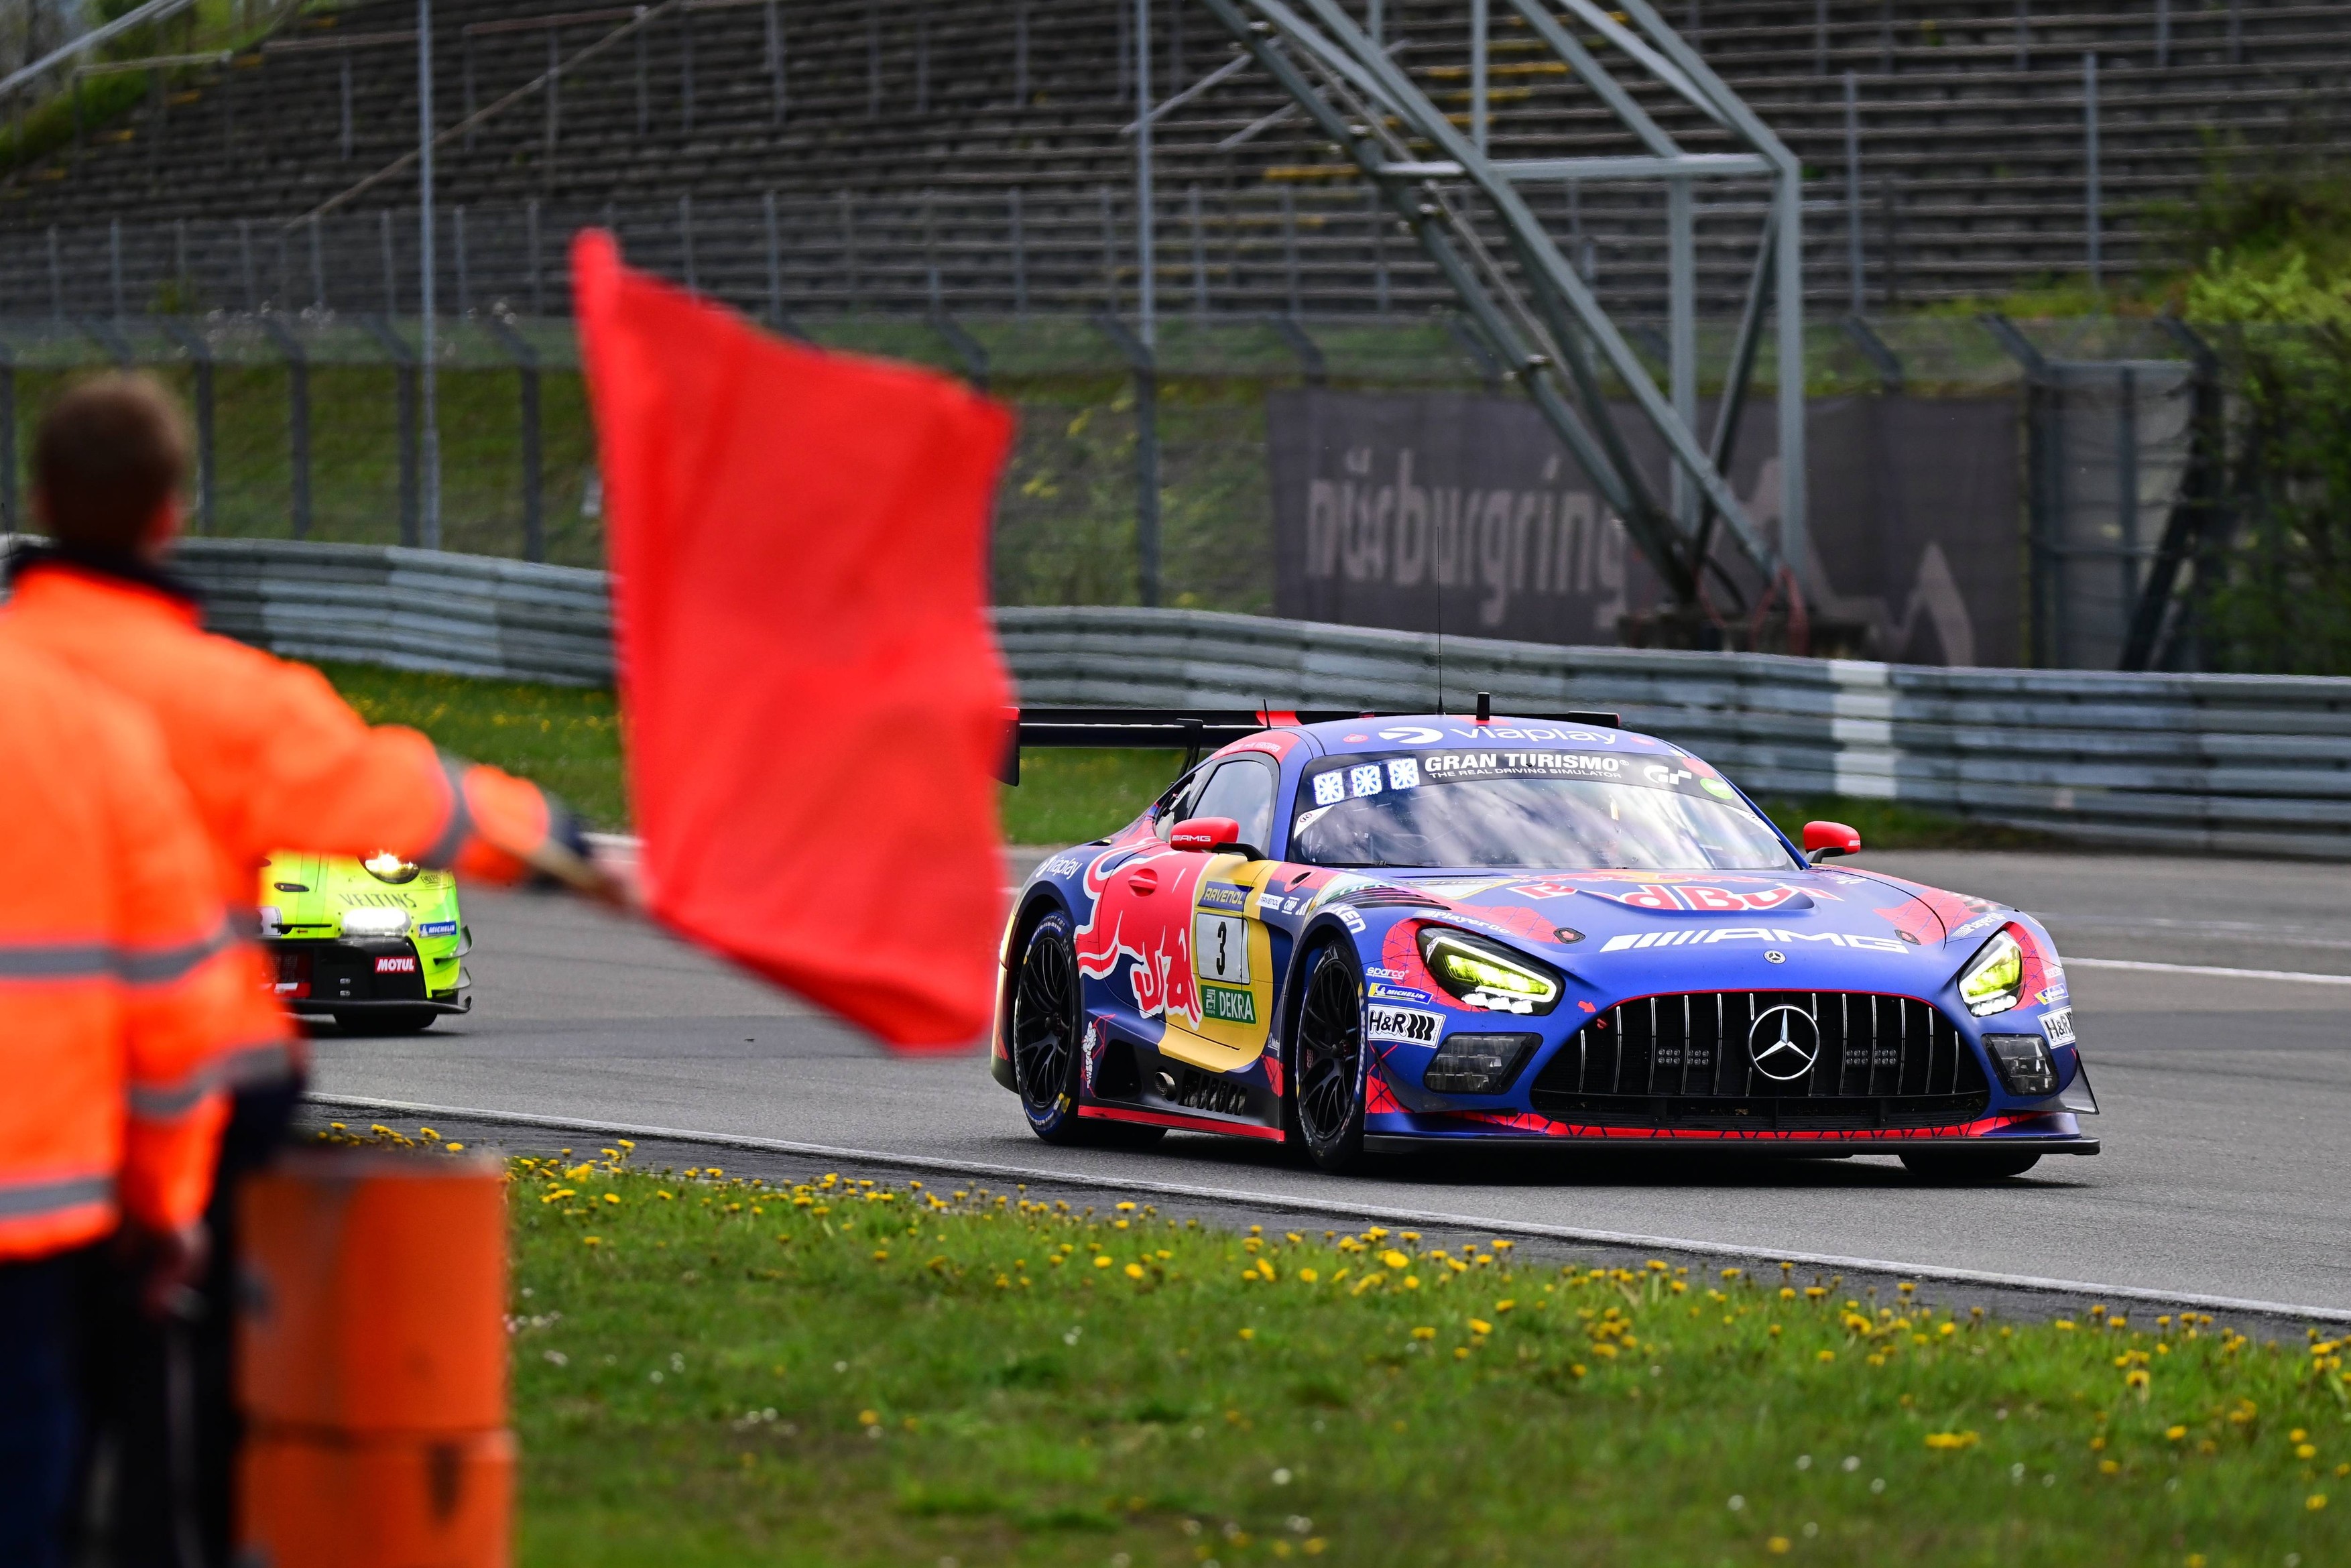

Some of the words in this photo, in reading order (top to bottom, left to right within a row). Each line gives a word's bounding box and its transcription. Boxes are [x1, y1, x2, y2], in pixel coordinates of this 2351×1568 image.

[1450, 725, 1616, 745] viaplay
[1425, 753, 1497, 772] GRAN
[1460, 769, 1493, 777] REAL
[1550, 768, 1622, 778] SIMULATOR
[1048, 857, 1083, 880] viaplay
[339, 893, 417, 908] VELTINS
[1205, 888, 1243, 905] RAVENOL
[1260, 896, 1279, 906] RAVENOL
[1283, 899, 1298, 911] OMP
[1506, 882, 1685, 910] Rd
[1329, 904, 1366, 934] LKEN
[428, 924, 455, 934] MICHELIN
[1216, 921, 1227, 975] 3
[1709, 928, 1910, 954] AMG
[377, 957, 414, 971] MOTUL
[1367, 967, 1405, 977] sparco
[1386, 989, 1426, 1000] MICHELIN
[1219, 991, 1254, 1021] DEKRA
[1370, 1010, 1406, 1034] H&R
[2045, 1014, 2068, 1040] H&R
